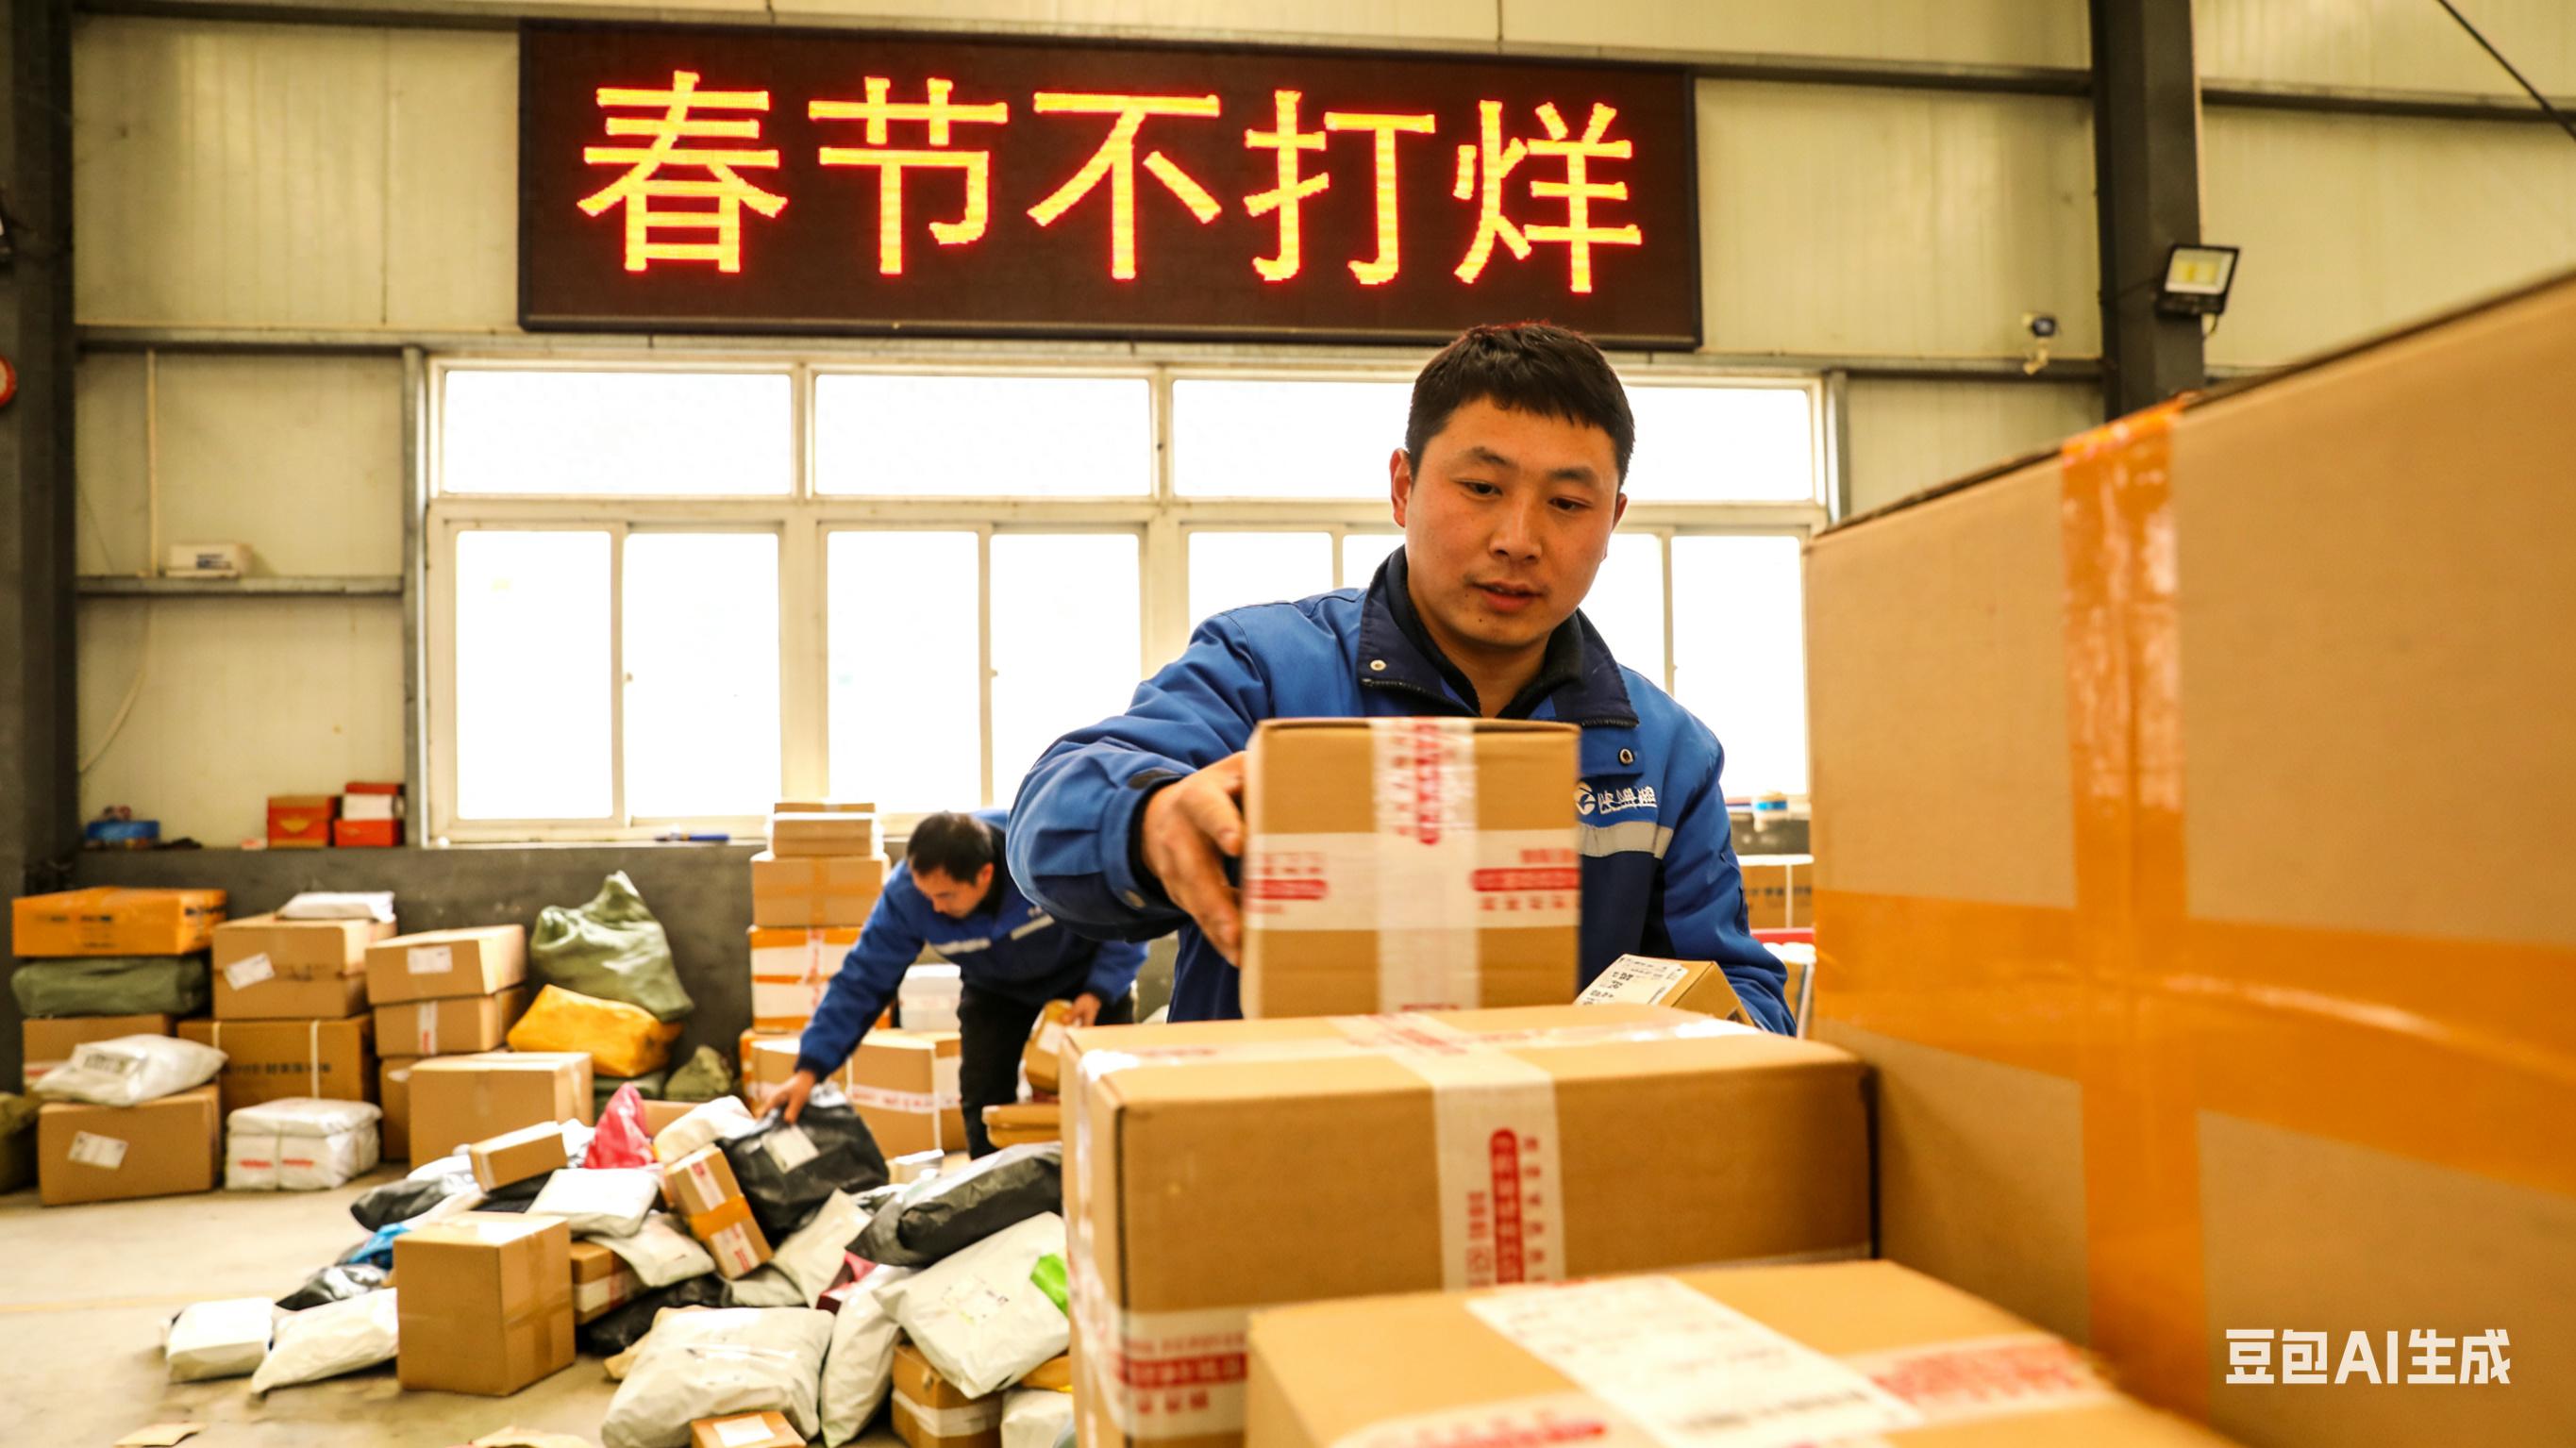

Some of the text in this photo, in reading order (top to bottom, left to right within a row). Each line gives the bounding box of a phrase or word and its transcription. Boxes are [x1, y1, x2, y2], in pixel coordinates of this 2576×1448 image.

[577, 71, 1642, 292] 春节不打烊
